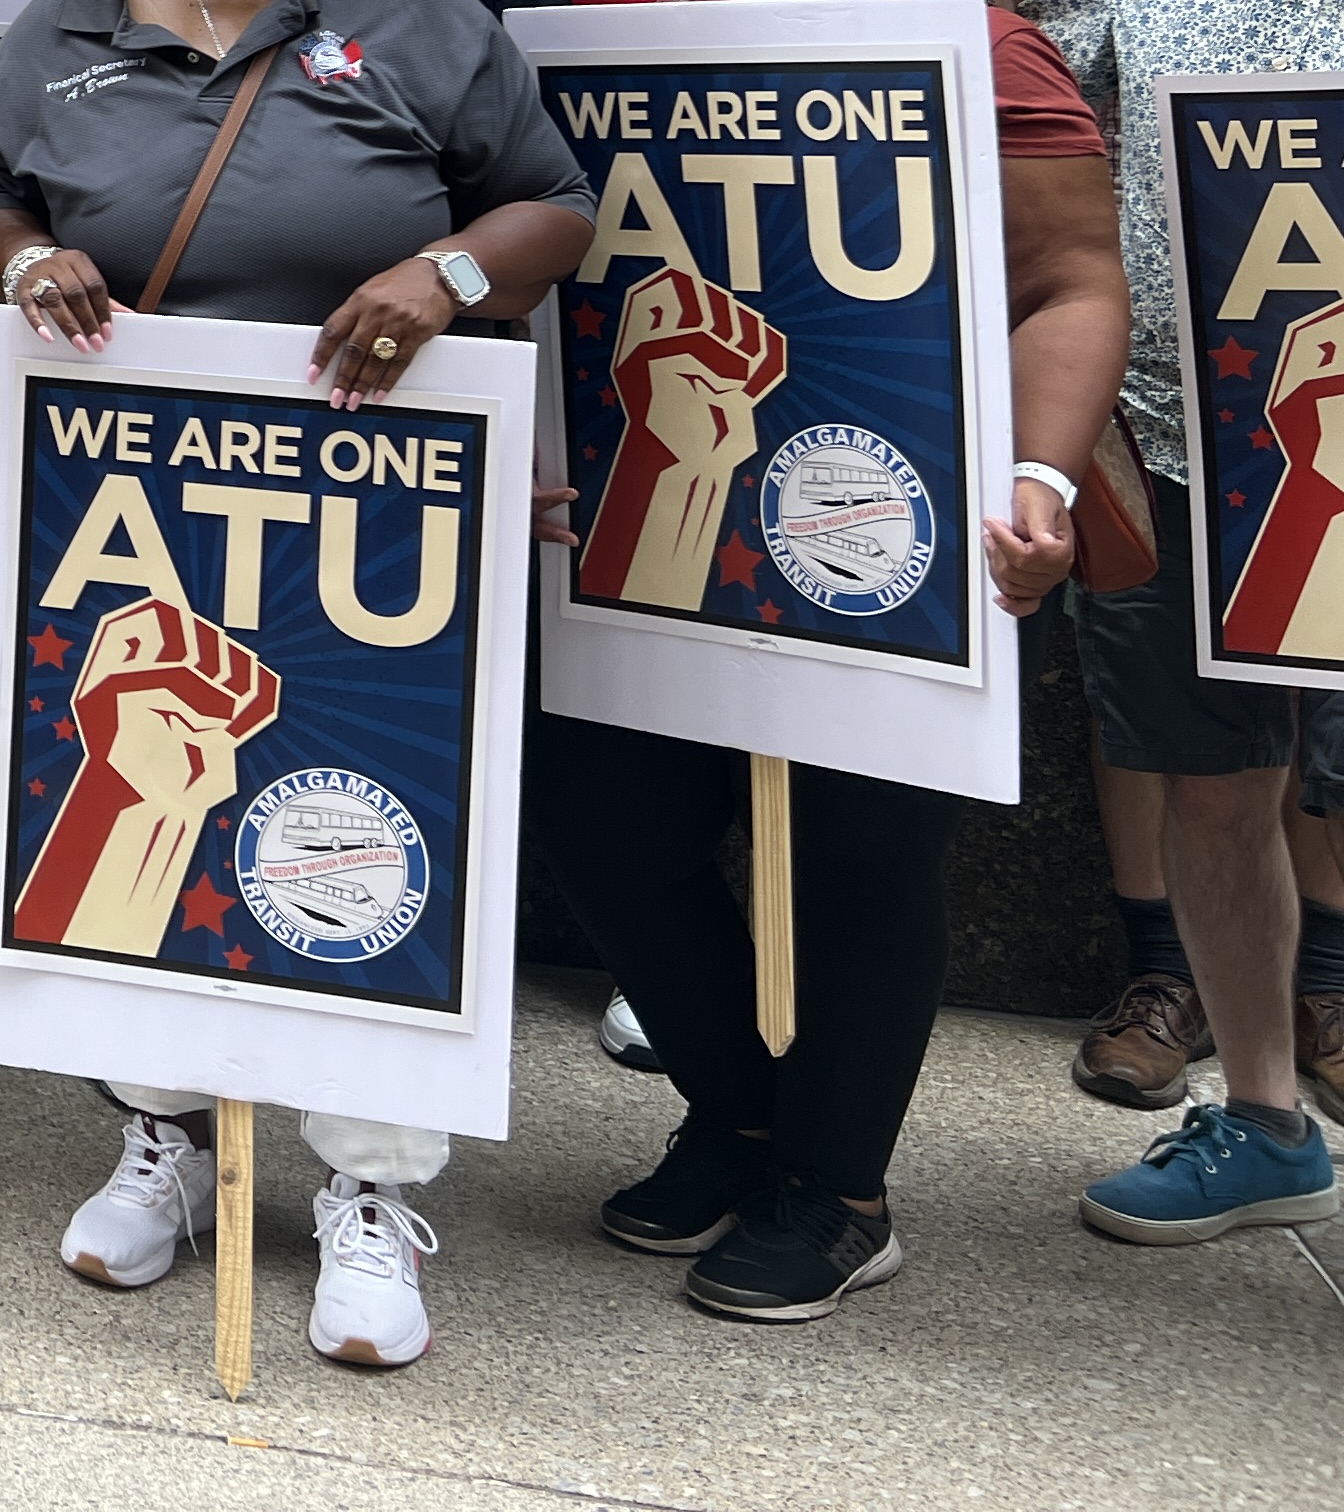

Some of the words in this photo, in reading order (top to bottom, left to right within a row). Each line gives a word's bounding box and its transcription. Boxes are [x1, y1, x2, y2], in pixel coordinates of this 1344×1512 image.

[559, 92, 652, 140] WE
[666, 91, 781, 141] ARE
[796, 89, 928, 141] ONE
[1197, 118, 1322, 170] WE
[576, 151, 934, 302] ATU
[47, 405, 153, 465] WE
[168, 417, 301, 477] ARE
[320, 430, 463, 493] ONE
[768, 427, 922, 499] AMALGAMATED
[39, 474, 459, 648] ATU
[765, 521, 837, 606] TRANSIT
[875, 540, 931, 607] UNION
[247, 771, 419, 847] AMALGAMATED
[263, 865, 300, 878] FREEDOM
[301, 859, 338, 874] THROUGH
[340, 850, 400, 867] ORGANIZATION
[239, 866, 317, 952] TRANSIT
[359, 888, 424, 954] UNION
